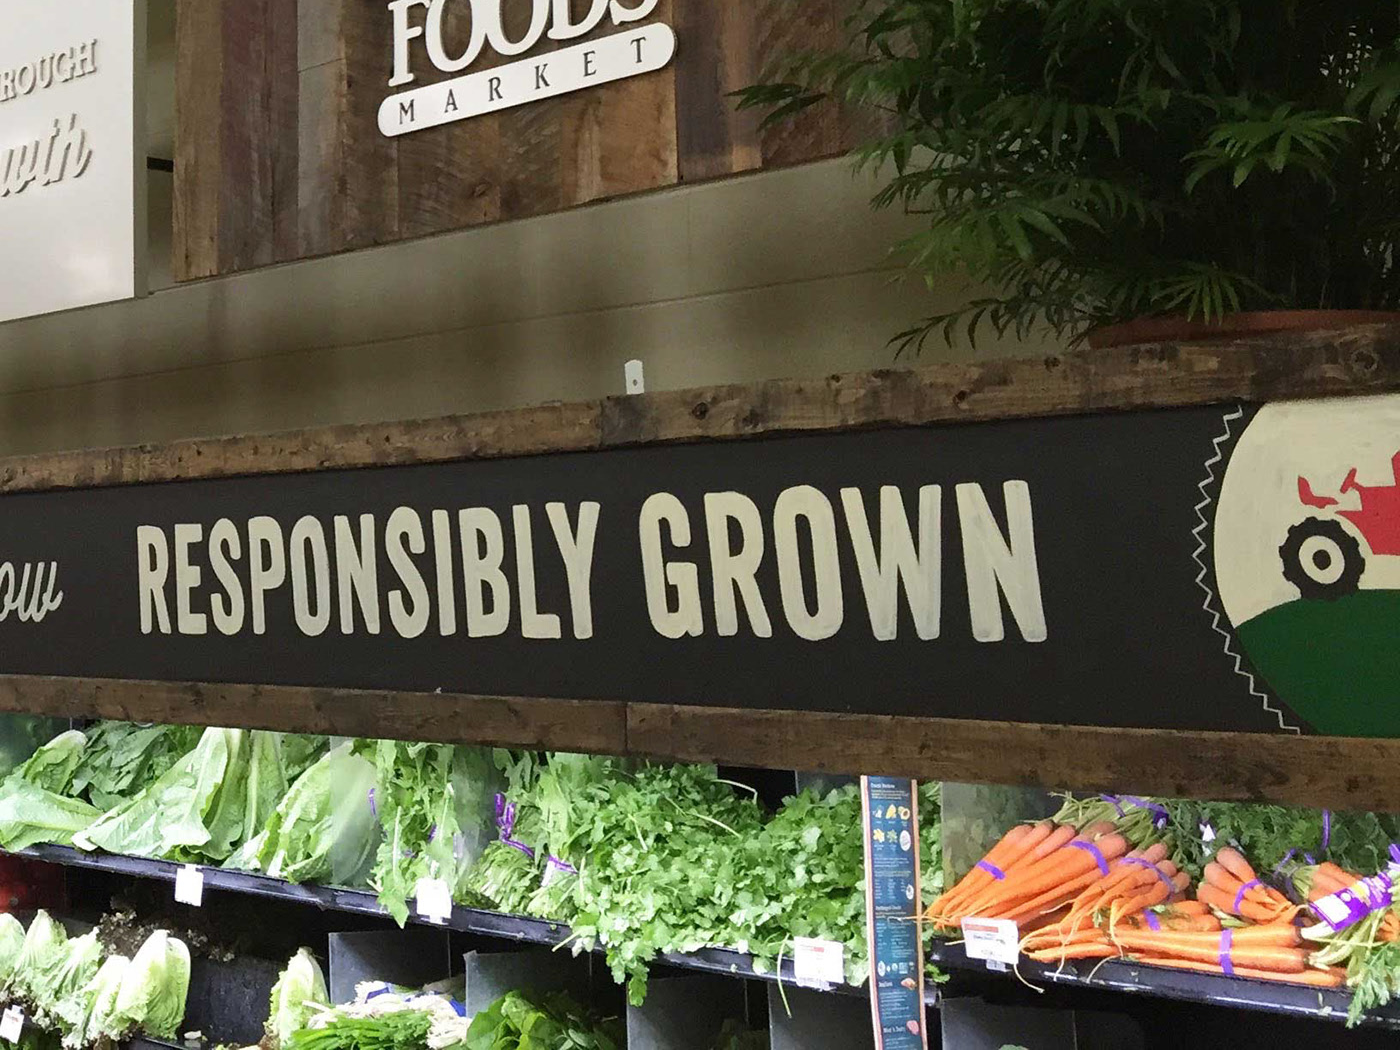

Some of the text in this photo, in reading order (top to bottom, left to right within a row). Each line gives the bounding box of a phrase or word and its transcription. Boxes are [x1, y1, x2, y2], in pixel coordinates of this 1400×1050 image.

[399, 36, 647, 125] MARKET
[136, 500, 601, 640] RESPONSIBLY
[638, 478, 1049, 643] GROWN
